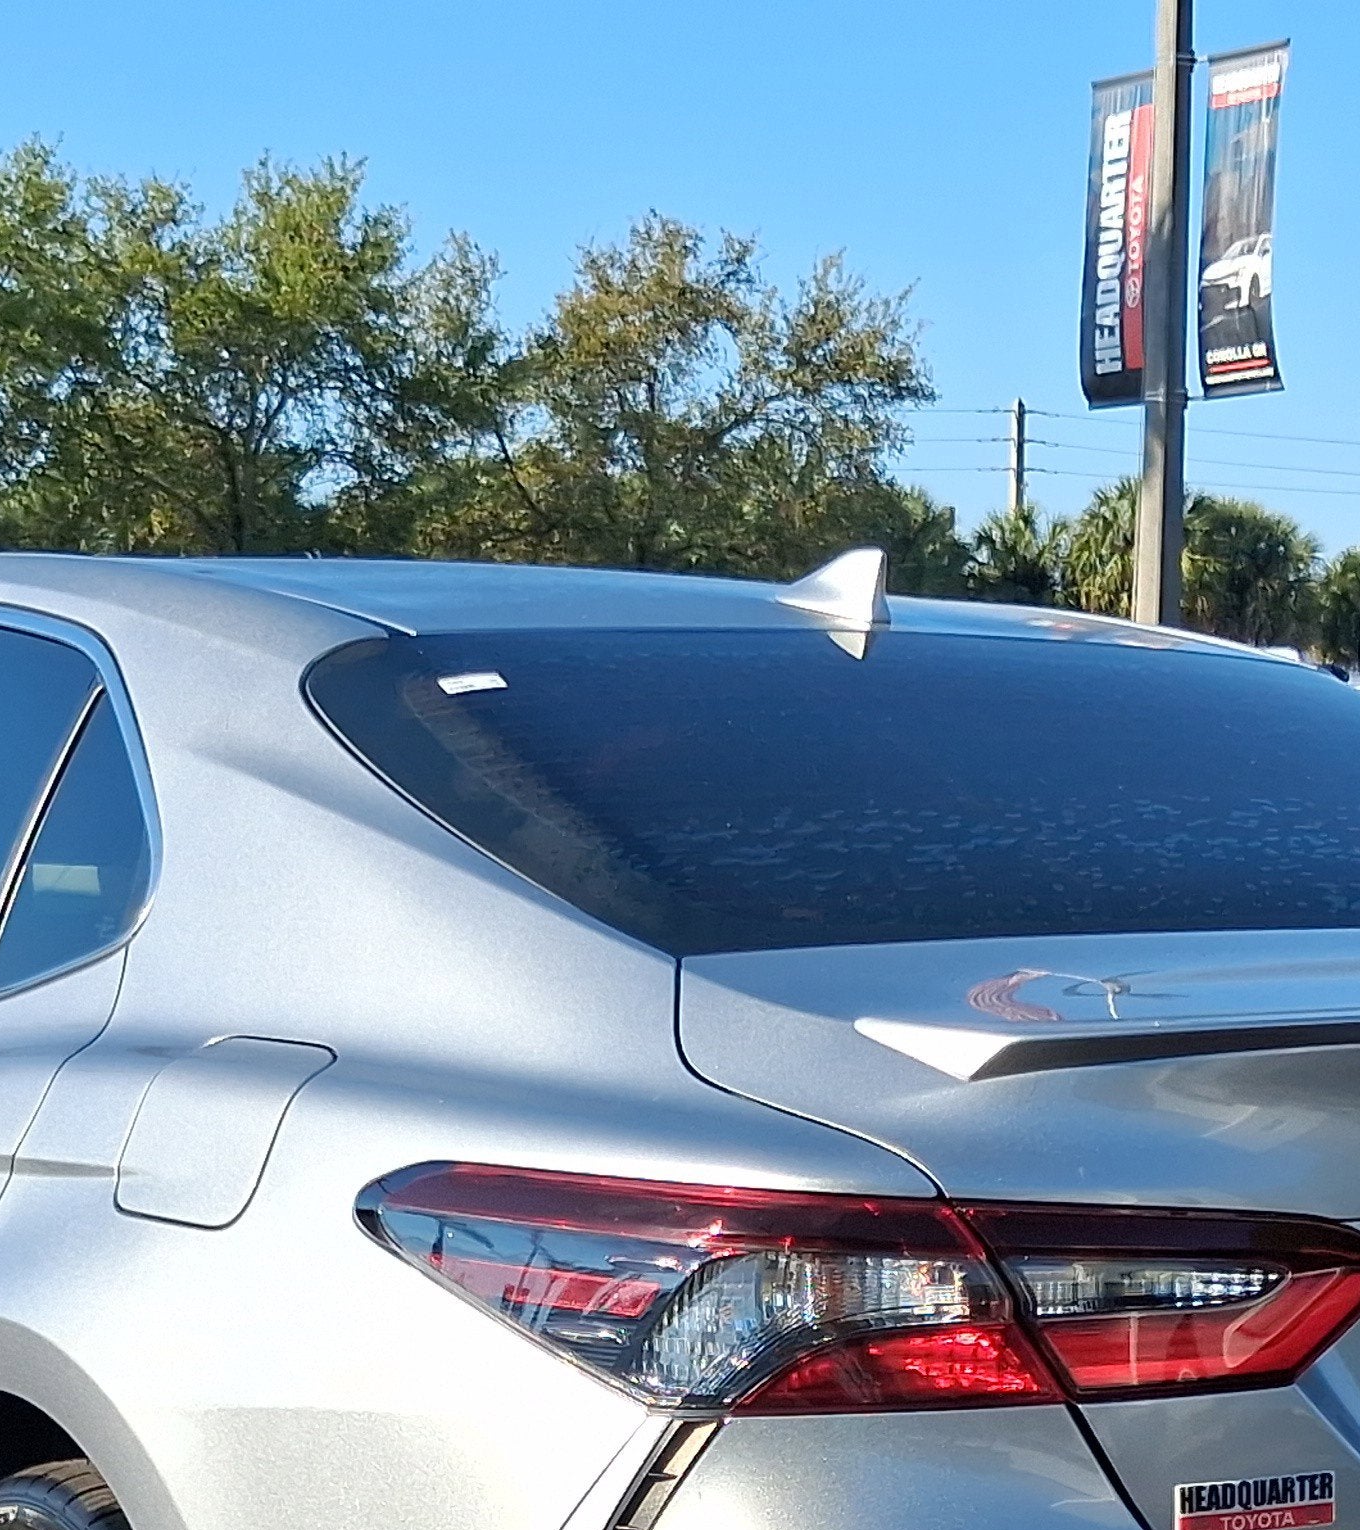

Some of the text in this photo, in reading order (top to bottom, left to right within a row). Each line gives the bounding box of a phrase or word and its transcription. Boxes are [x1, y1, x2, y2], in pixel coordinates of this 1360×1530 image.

[1095, 109, 1134, 376] HEADQUARTER
[1128, 176, 1145, 274] TOYOTA
[1180, 1473, 1334, 1514] HEADQUARTER
